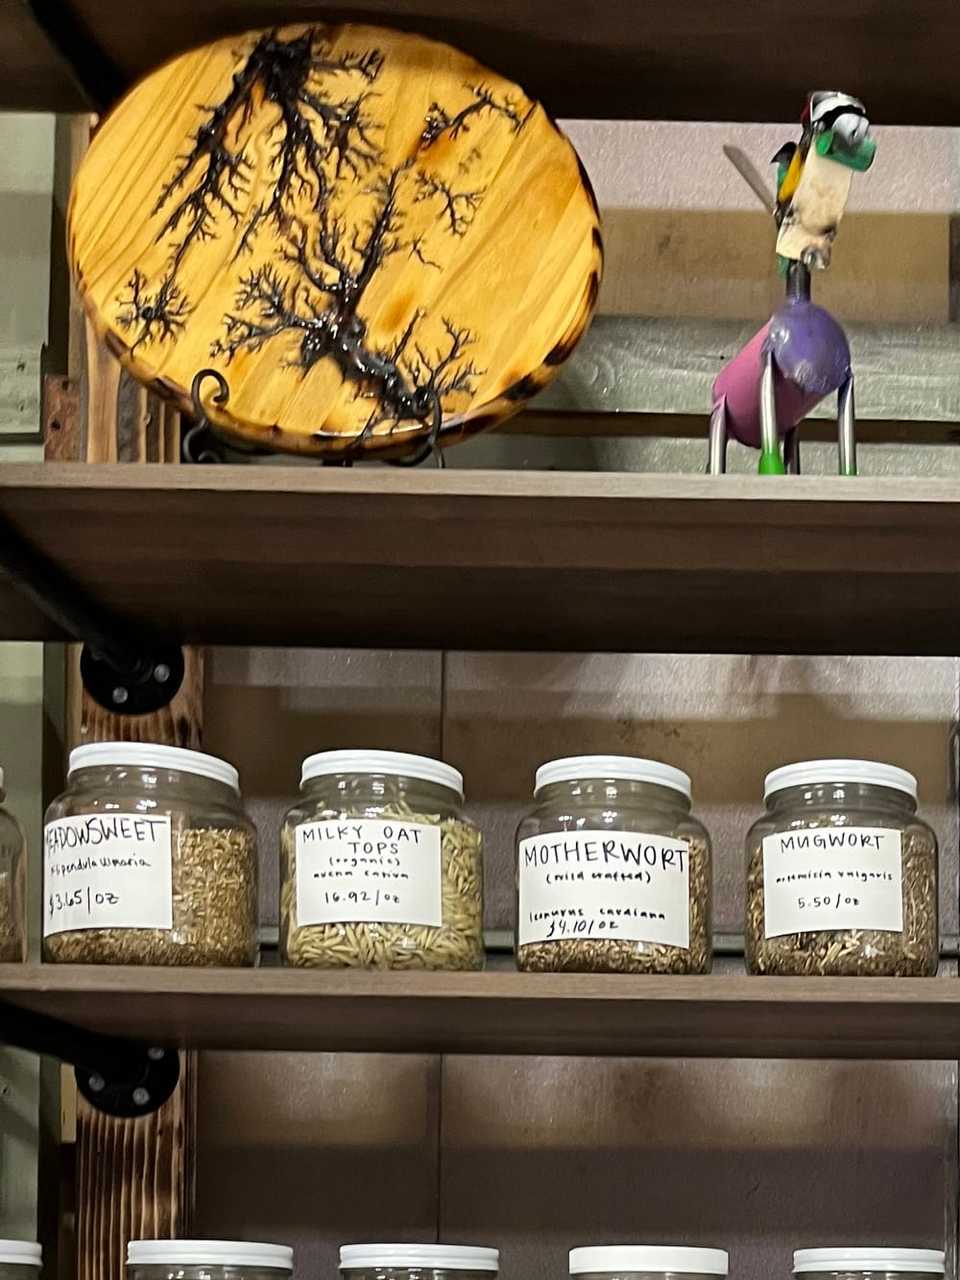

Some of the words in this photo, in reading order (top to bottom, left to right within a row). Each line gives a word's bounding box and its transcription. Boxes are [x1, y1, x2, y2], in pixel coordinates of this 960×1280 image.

[302, 824, 363, 844] MILKY
[383, 825, 422, 845] OAT
[780, 831, 886, 854] MUGWORT
[346, 841, 399, 856] TOPS
[524, 839, 686, 872] MOTHERWORT
